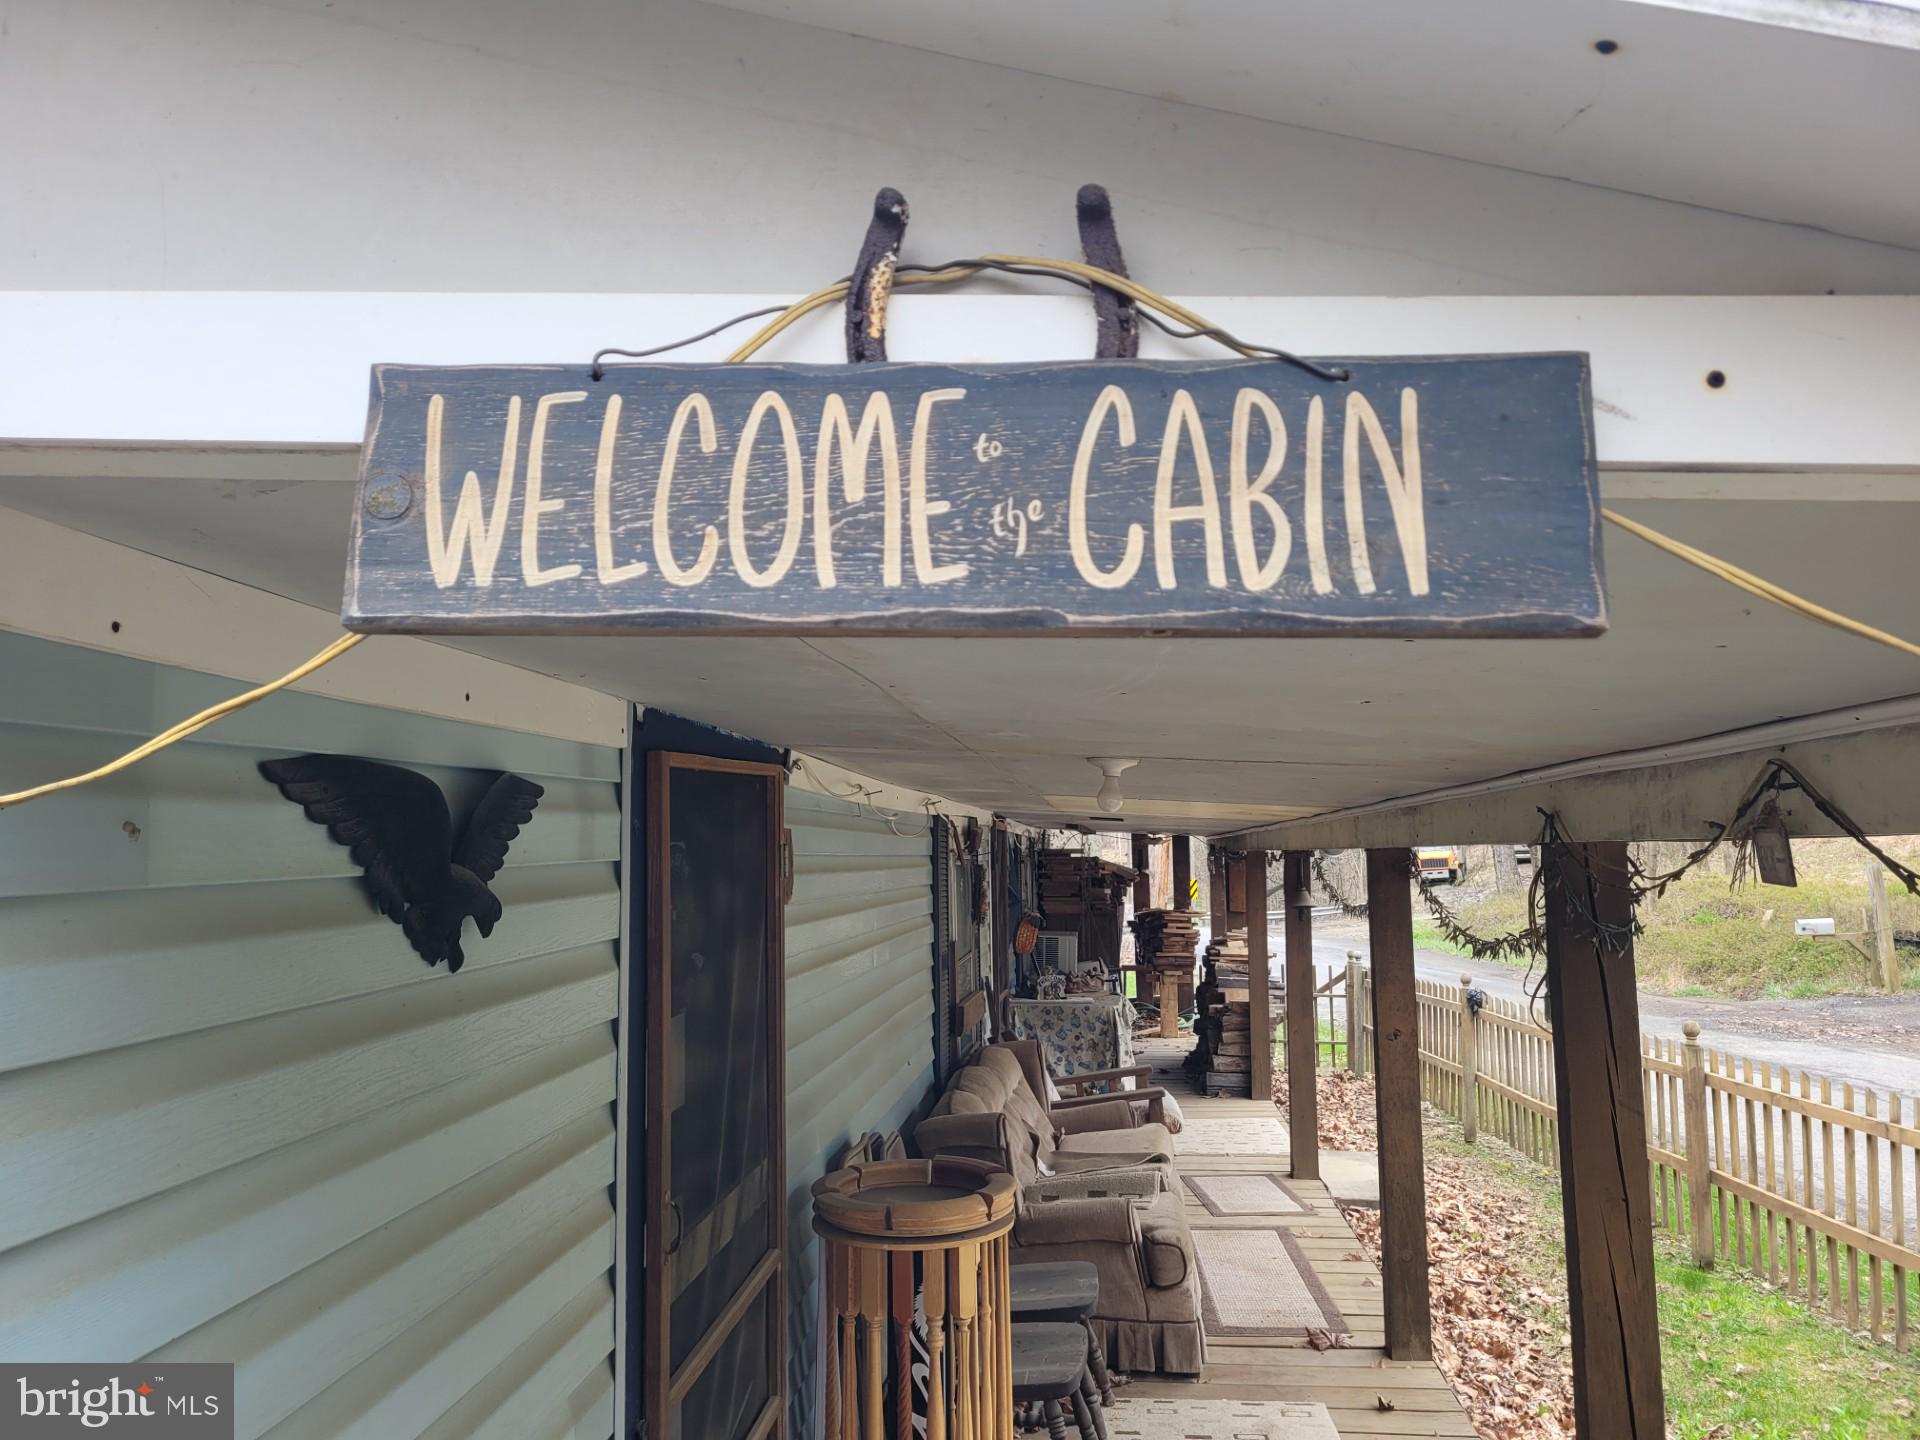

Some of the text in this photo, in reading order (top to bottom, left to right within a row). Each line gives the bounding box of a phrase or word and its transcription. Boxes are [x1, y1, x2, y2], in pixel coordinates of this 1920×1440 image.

[424, 389, 970, 589] WELCOME
[976, 432, 1003, 463] to
[1068, 384, 1430, 597] CABIN
[988, 496, 1045, 558] the
